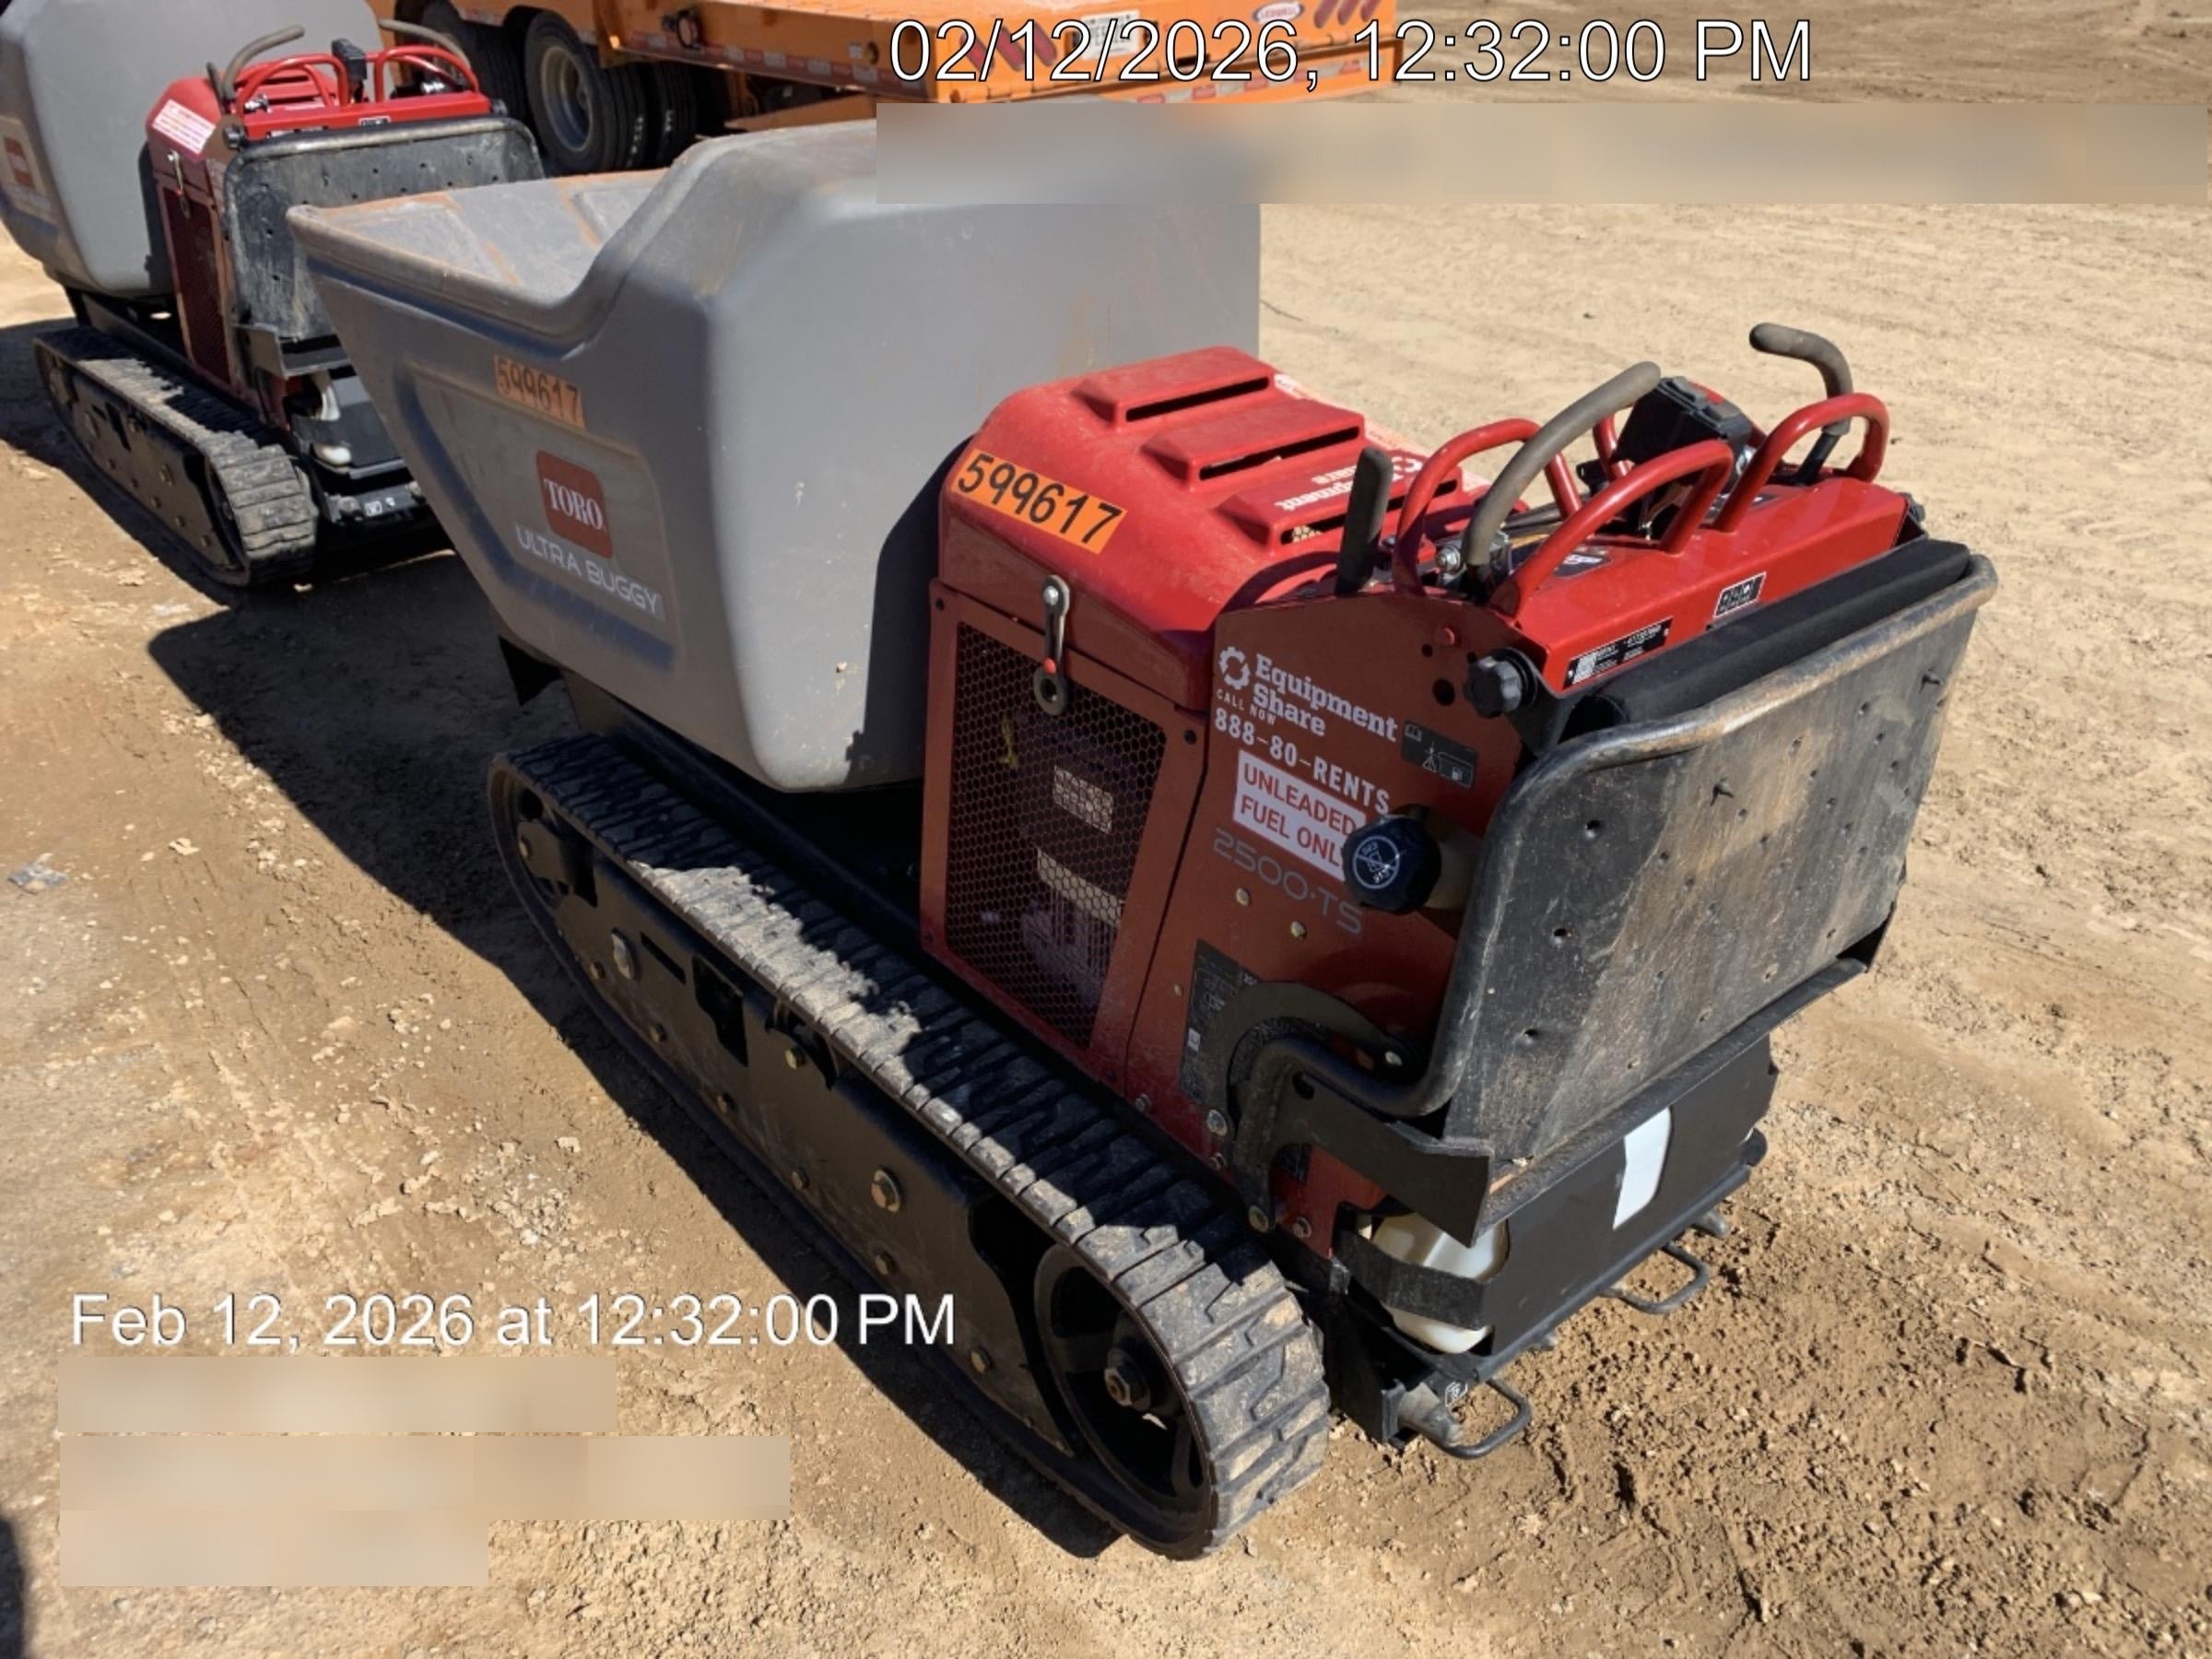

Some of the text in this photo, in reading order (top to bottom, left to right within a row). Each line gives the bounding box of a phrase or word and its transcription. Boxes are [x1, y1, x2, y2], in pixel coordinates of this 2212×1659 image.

[497, 360, 579, 421] 599617
[543, 478, 604, 530] TORO
[958, 453, 1124, 545] 599617
[515, 524, 658, 613] ULTRA BUGGY
[1217, 688, 1277, 725] CALL NOW
[1253, 683, 1326, 736] Share
[1255, 653, 1398, 742] Equipment
[1215, 707, 1390, 815] 888-80-RENTS
[1241, 794, 1342, 866] FUEL ONL
[1244, 762, 1358, 837] UNLEADED
